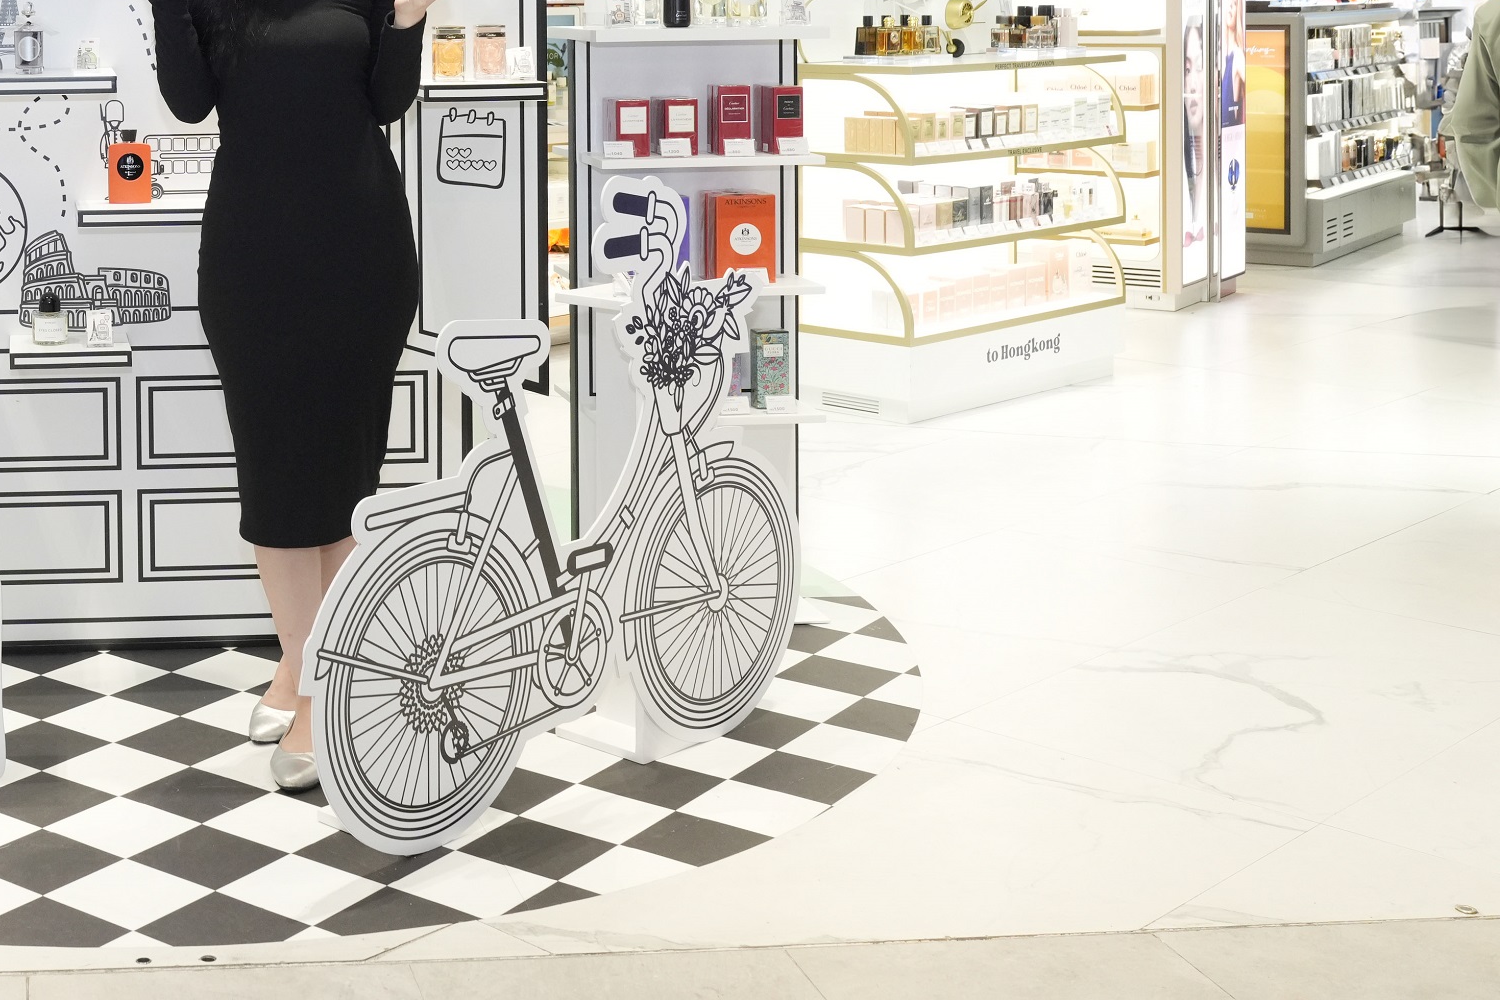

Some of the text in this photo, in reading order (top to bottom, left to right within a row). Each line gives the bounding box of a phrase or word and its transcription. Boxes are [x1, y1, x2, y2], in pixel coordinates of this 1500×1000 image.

[995, 60, 1055, 70] PERFECT TRAVELER COMPANION
[1008, 146, 1042, 155] TRAVEL EXCLUSIVE
[986, 333, 1061, 363] to Hongkong
